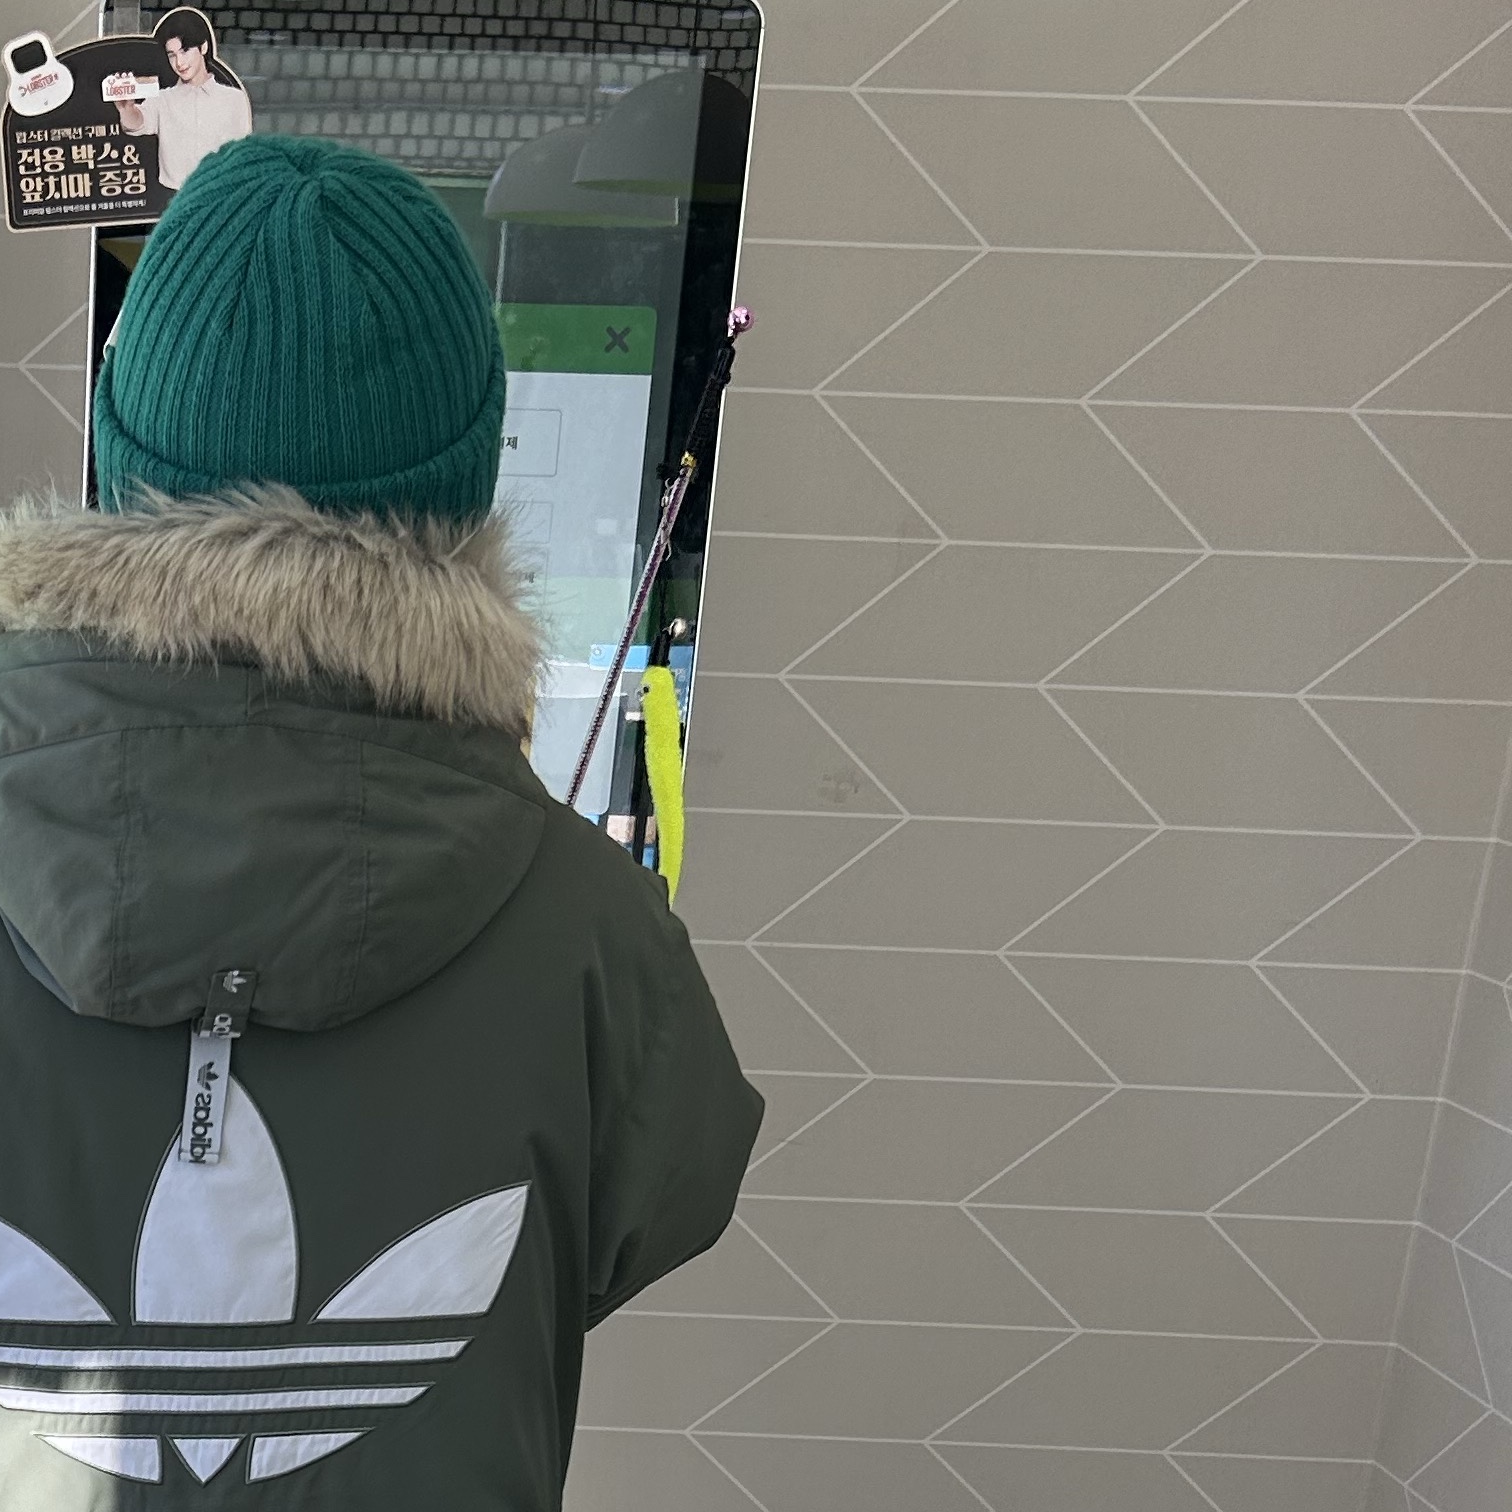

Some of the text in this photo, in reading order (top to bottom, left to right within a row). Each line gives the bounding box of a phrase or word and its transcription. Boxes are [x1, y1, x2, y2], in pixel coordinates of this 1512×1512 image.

[105, 84, 136, 97] LOBSTER
[15, 129, 48, 143] 랍스터
[84, 125, 106, 138] 구매
[109, 123, 120, 137] 시
[17, 147, 66, 175] 전용
[19, 168, 147, 204] 앞치마 증정
[500, 435, 519, 451] 제
